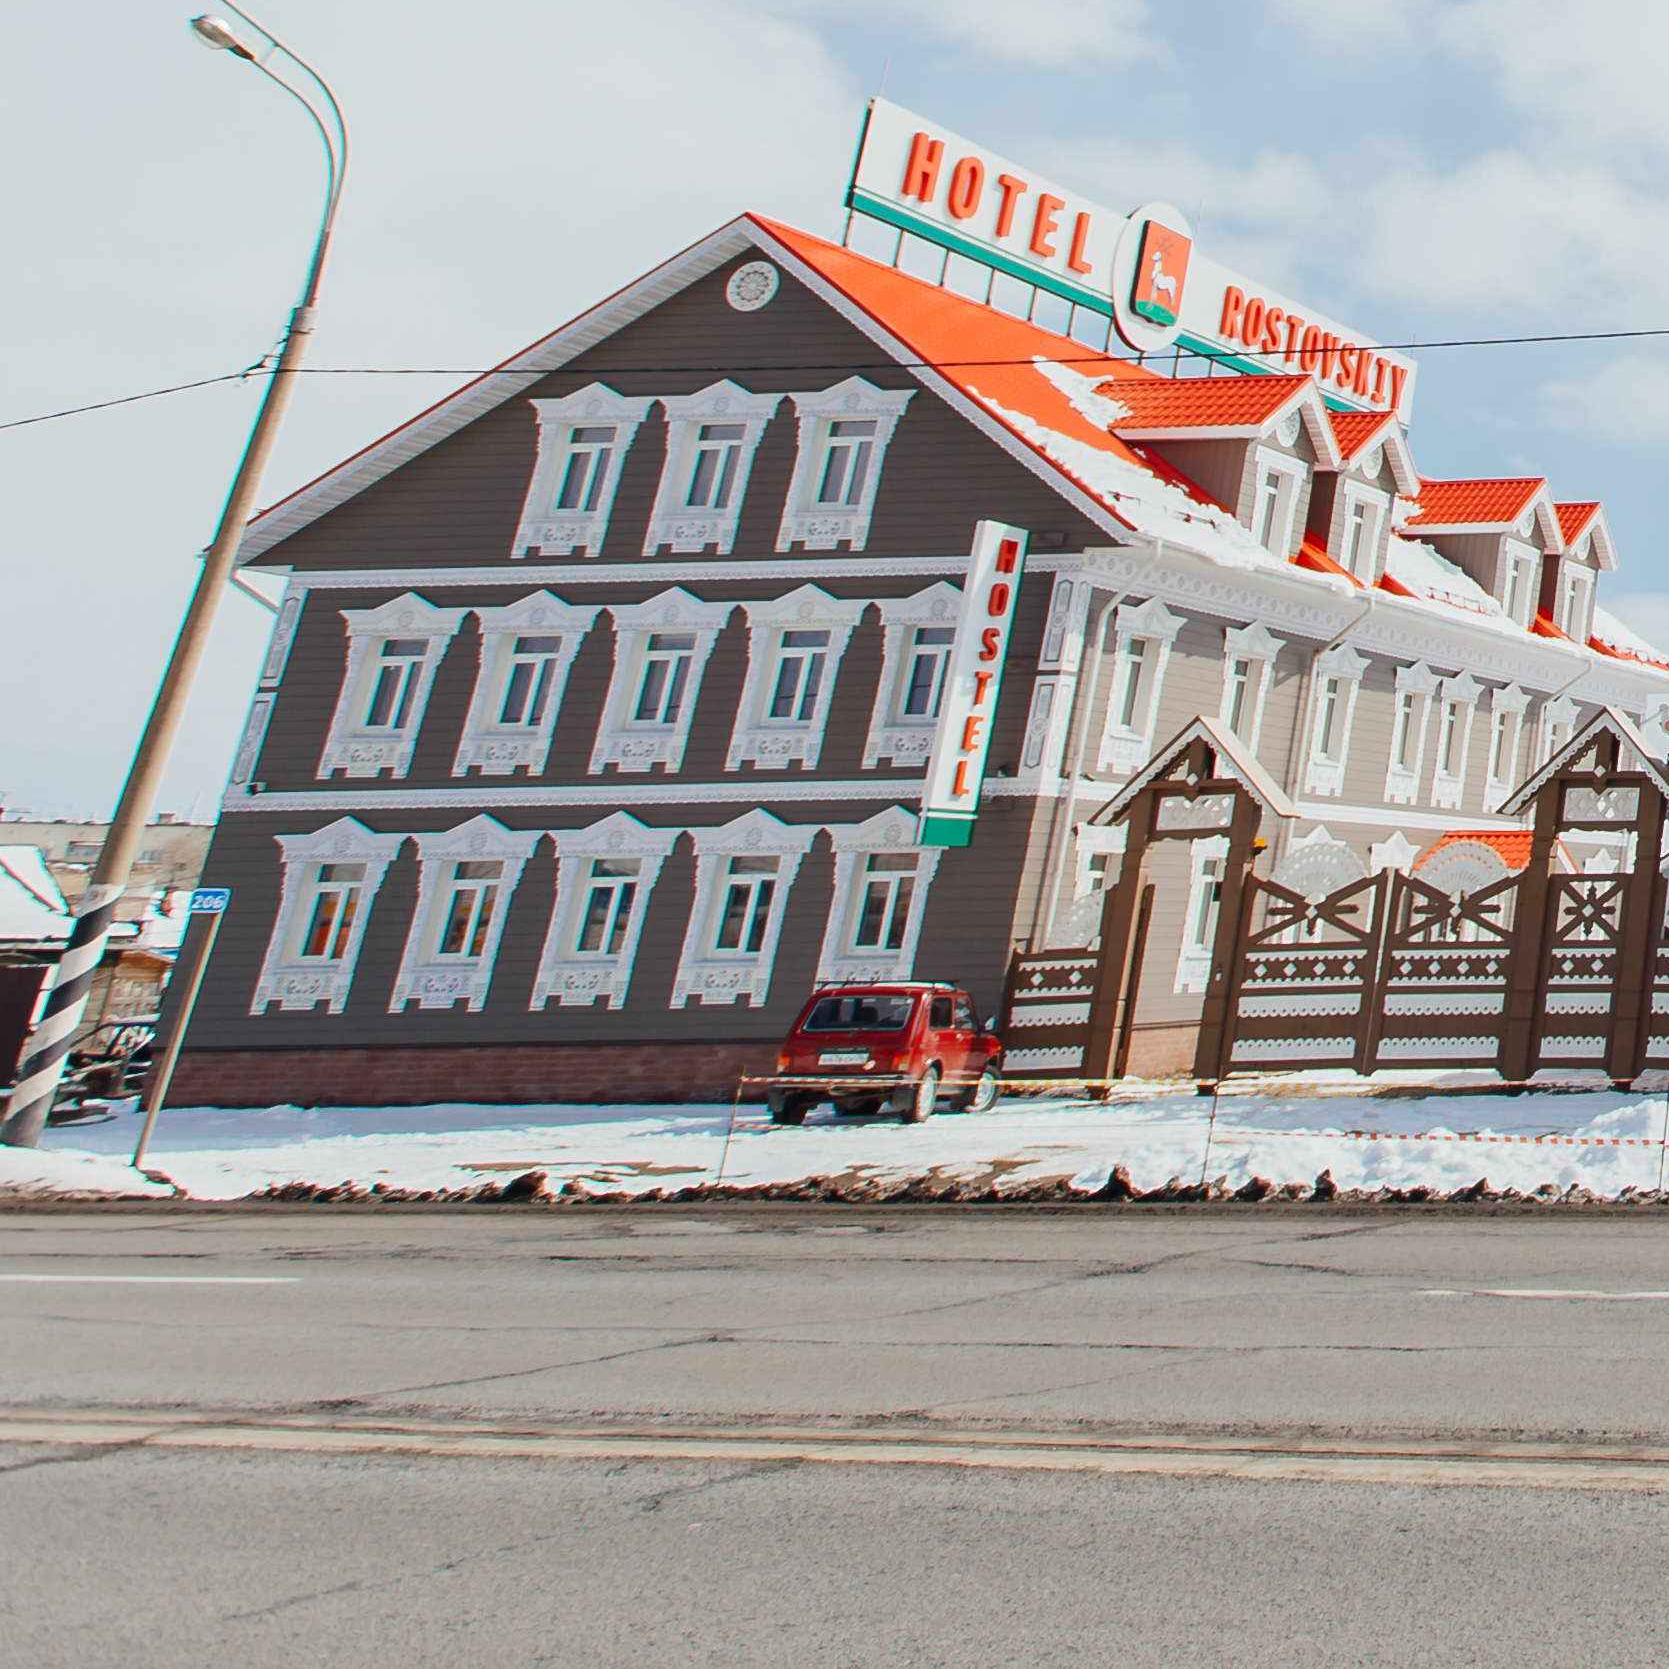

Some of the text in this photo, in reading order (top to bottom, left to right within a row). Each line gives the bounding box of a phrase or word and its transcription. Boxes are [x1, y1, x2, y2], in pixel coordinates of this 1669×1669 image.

[902, 131, 1408, 411] HOTEL ROSTOVSKIY
[953, 538, 1019, 797] HOSTEL
